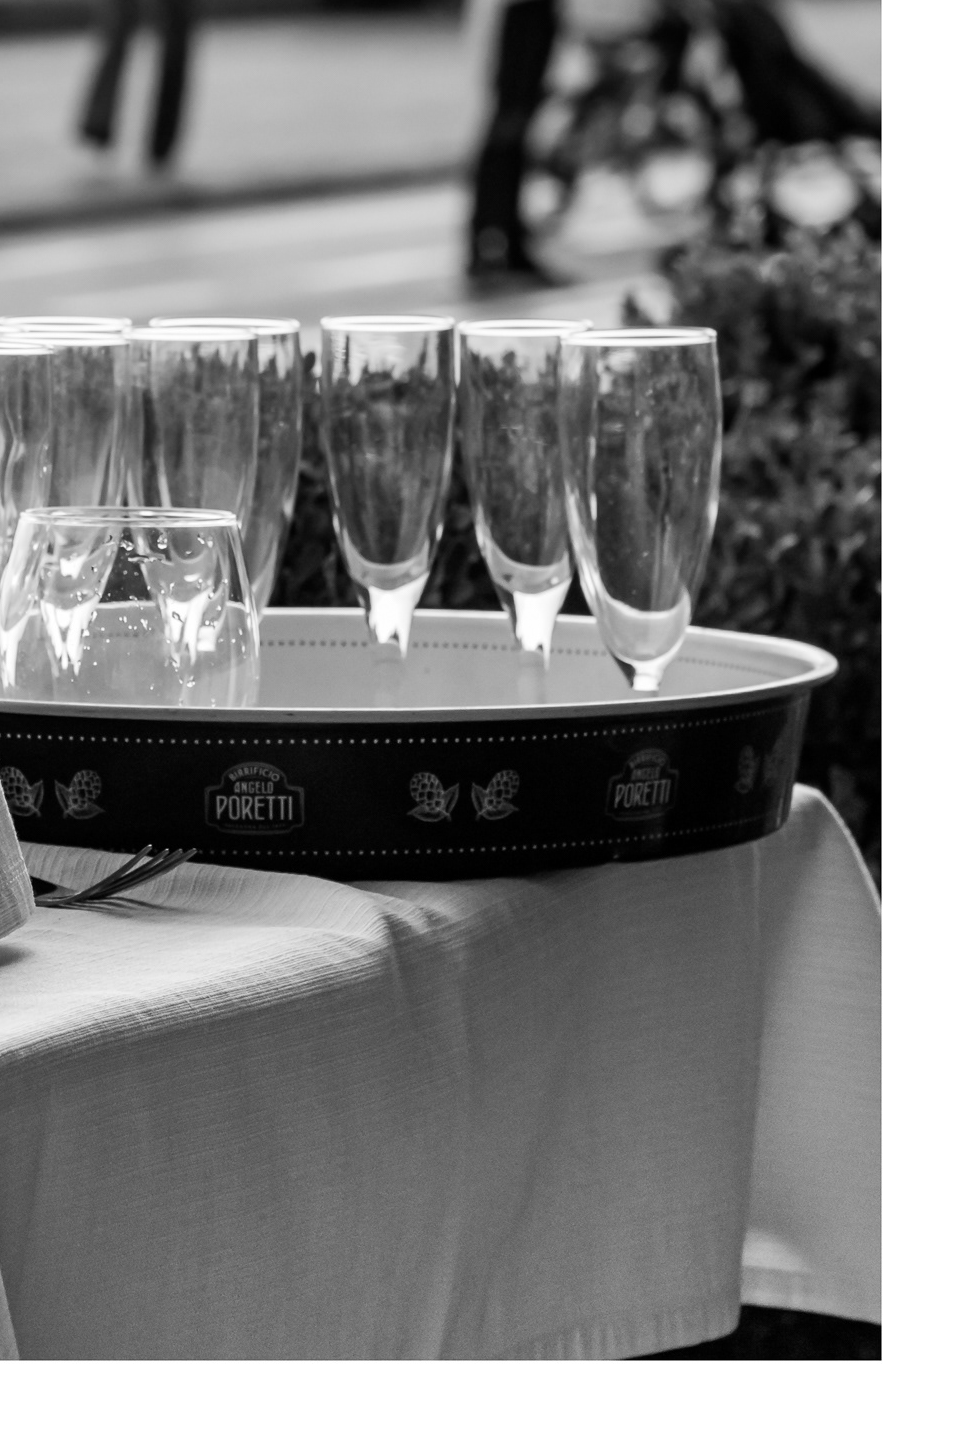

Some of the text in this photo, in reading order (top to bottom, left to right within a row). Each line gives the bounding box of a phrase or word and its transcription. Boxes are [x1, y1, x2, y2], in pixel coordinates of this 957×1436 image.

[234, 781, 274, 794] ANGELO
[614, 779, 671, 809] PORETTI
[216, 795, 293, 820] PORETTI
